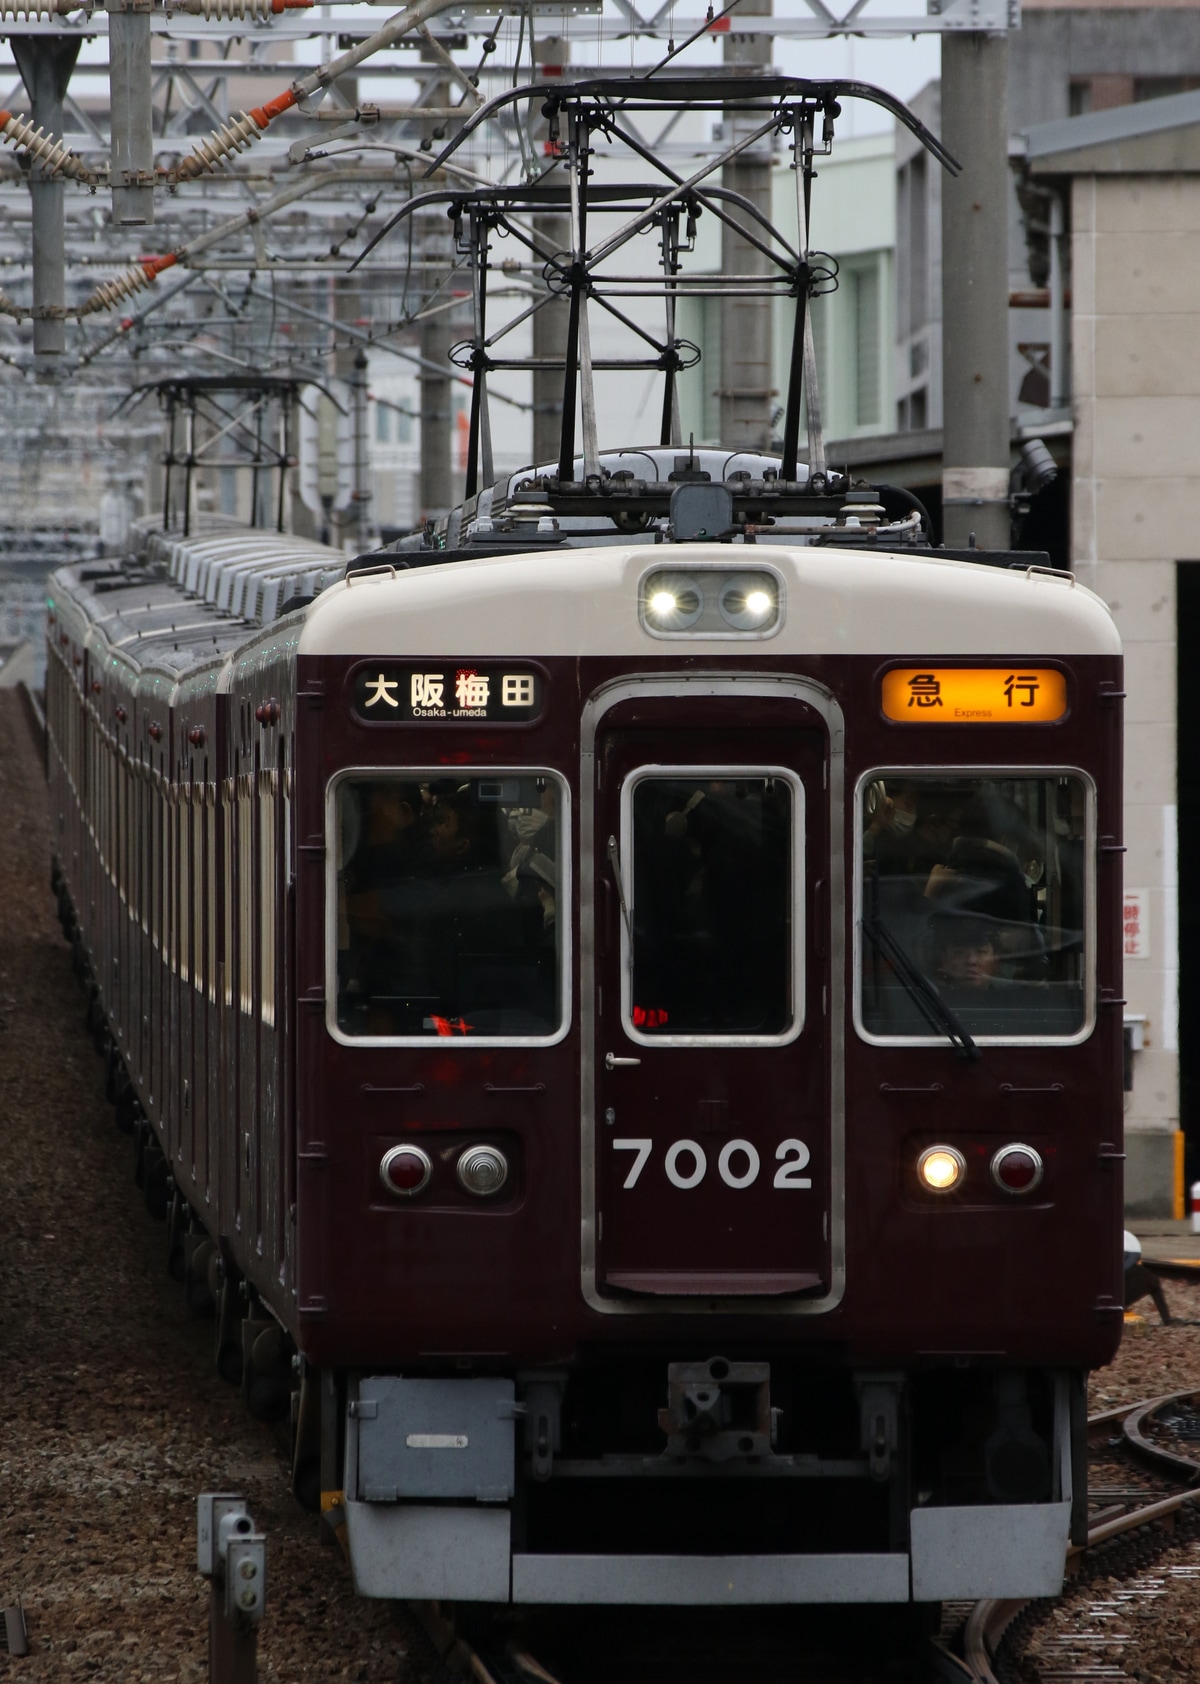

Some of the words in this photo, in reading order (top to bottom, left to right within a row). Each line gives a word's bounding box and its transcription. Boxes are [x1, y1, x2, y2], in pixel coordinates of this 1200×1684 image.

[365, 673, 534, 707] 大阪梅田
[907, 674, 1040, 707] 急行
[413, 707, 487, 717] Osaka-umeda
[955, 708, 992, 718] Express
[613, 1138, 812, 1190] 7002
